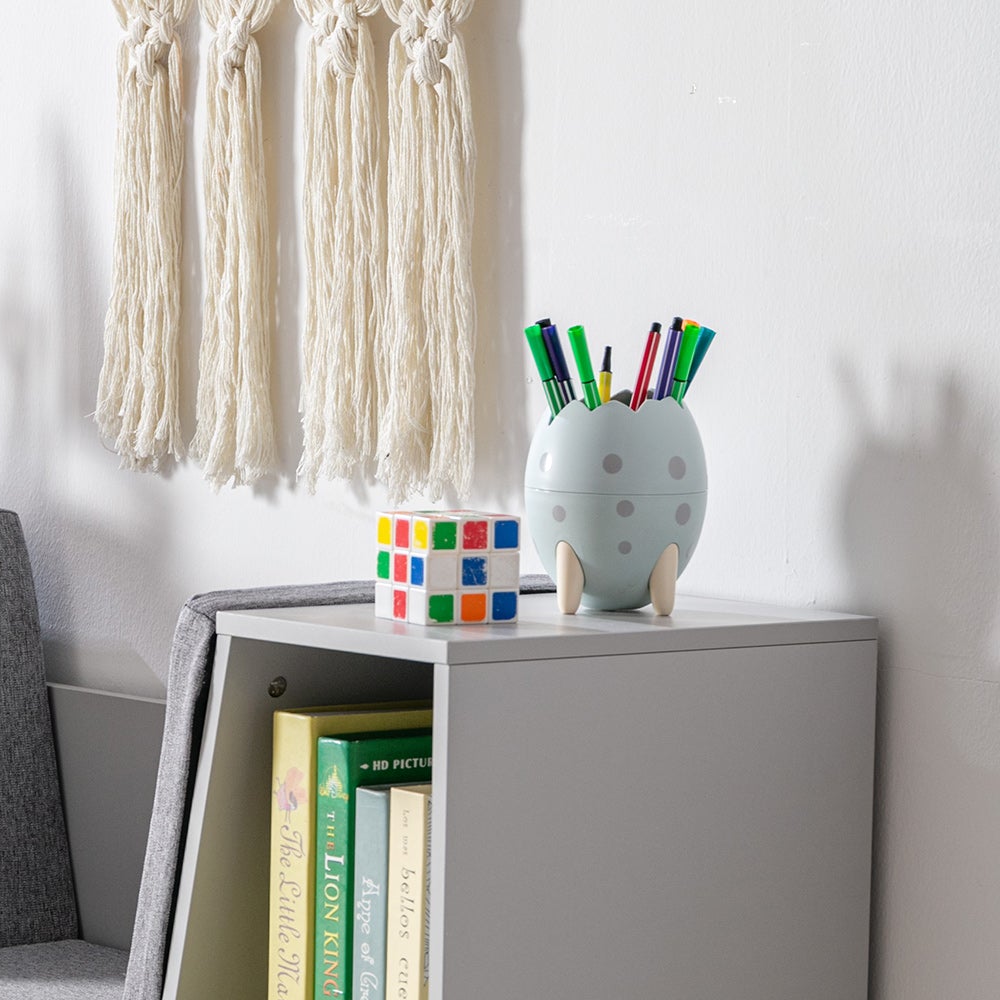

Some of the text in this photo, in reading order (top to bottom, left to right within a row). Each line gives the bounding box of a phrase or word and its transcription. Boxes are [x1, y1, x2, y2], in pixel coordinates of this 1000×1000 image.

[372, 760, 389, 772] HD
[278, 824, 306, 868] The
[325, 810, 336, 851] THE
[278, 870, 302, 943] Little
[323, 852, 345, 922] LION
[356, 875, 381, 935] Anne
[399, 866, 416, 940] bellos
[323, 931, 341, 998] KING
[360, 941, 375, 966] of
